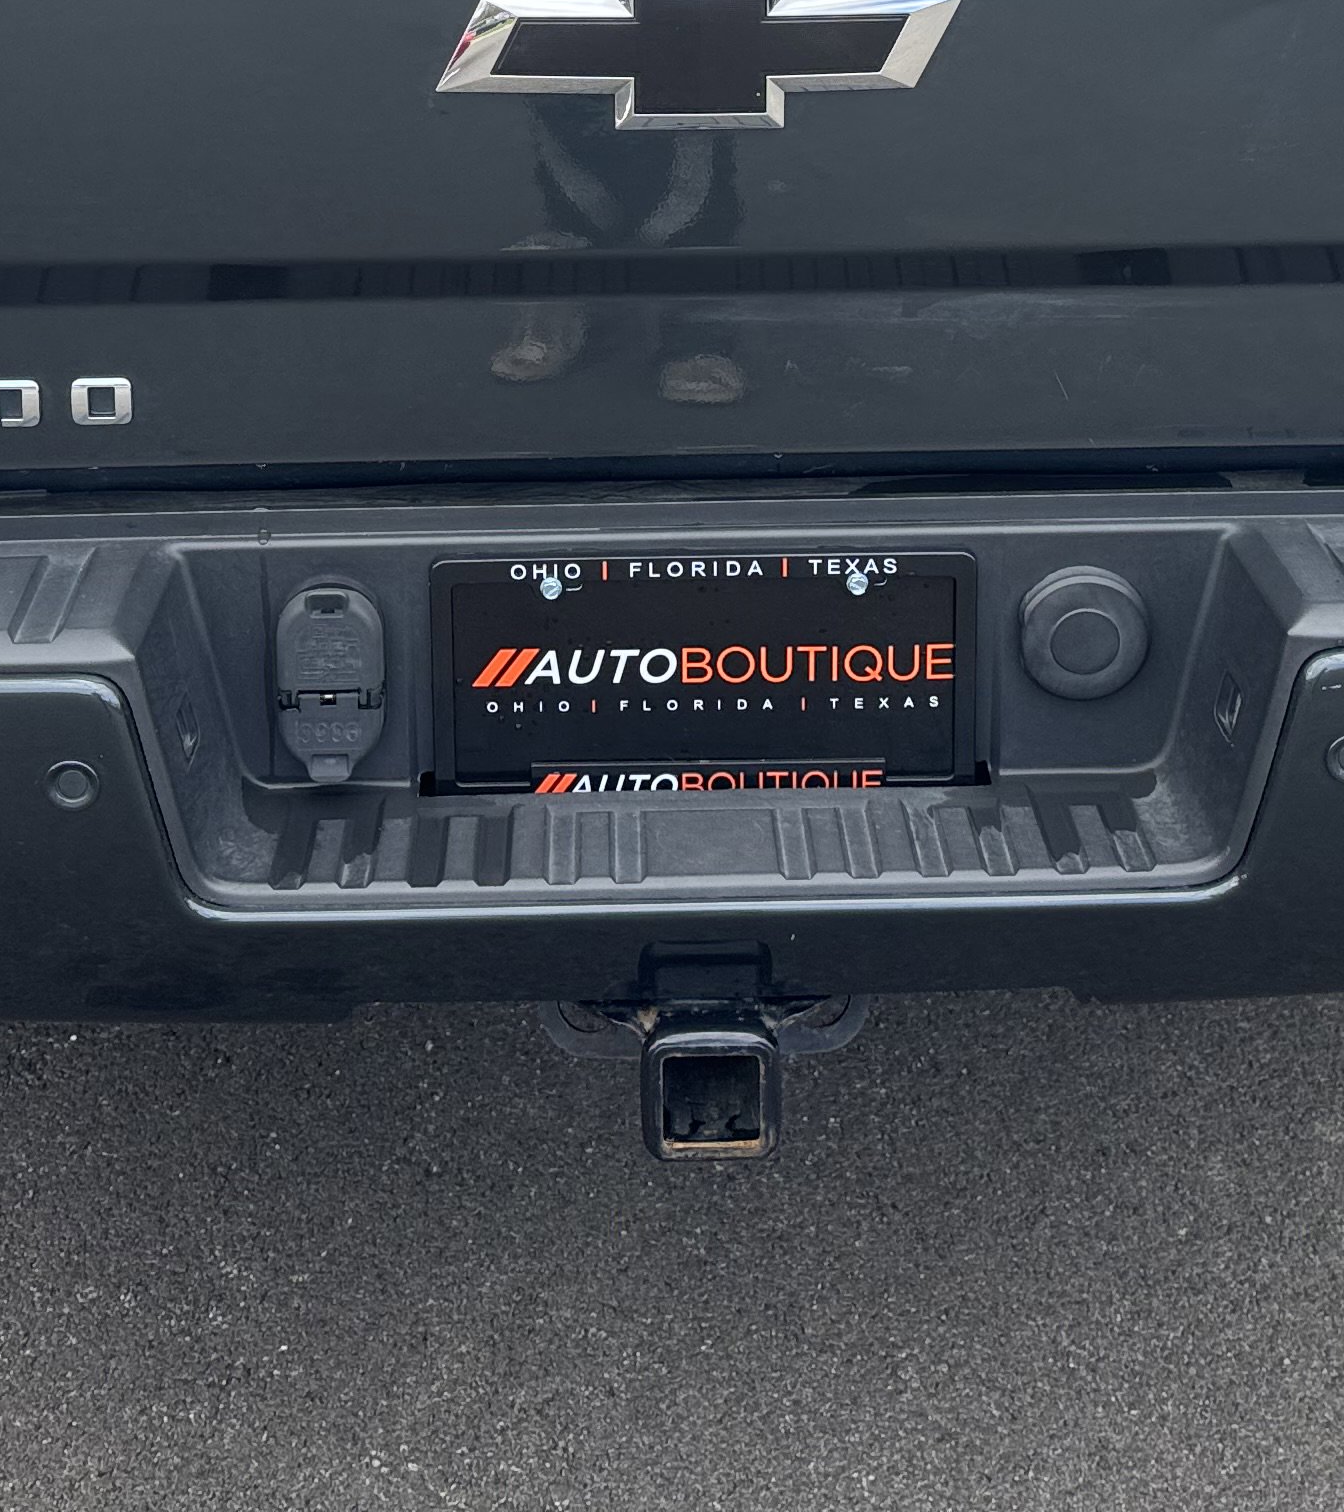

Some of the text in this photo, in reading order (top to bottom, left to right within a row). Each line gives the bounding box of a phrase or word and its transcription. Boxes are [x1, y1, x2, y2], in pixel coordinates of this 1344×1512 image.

[509, 557, 899, 581] OHIO FLORIDA TEXAS
[524, 643, 955, 686] AUTOBOUTIQUE
[486, 694, 941, 714] OHIO FLORIDA TEXAS
